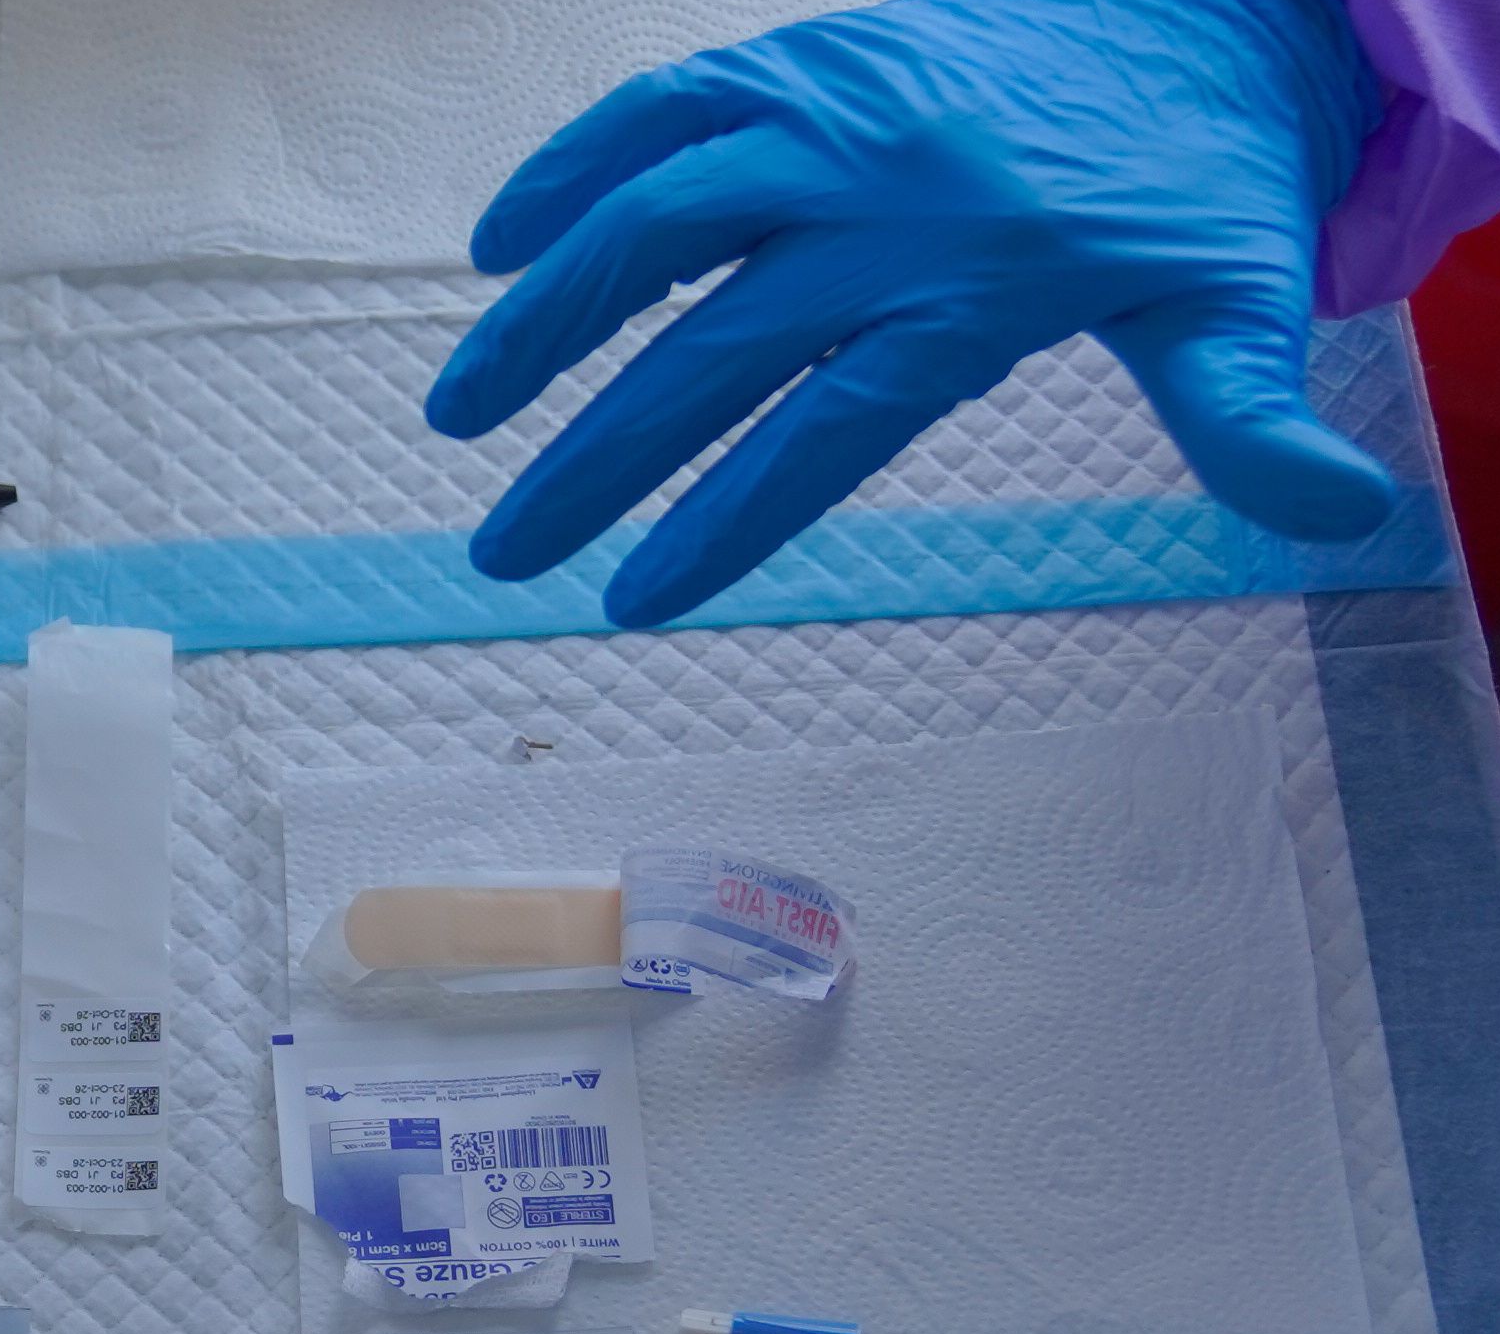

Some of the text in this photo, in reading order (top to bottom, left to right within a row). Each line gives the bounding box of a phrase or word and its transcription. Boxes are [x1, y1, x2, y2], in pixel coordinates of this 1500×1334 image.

[478, 1237, 620, 1252] WHITE 100% COTTON
